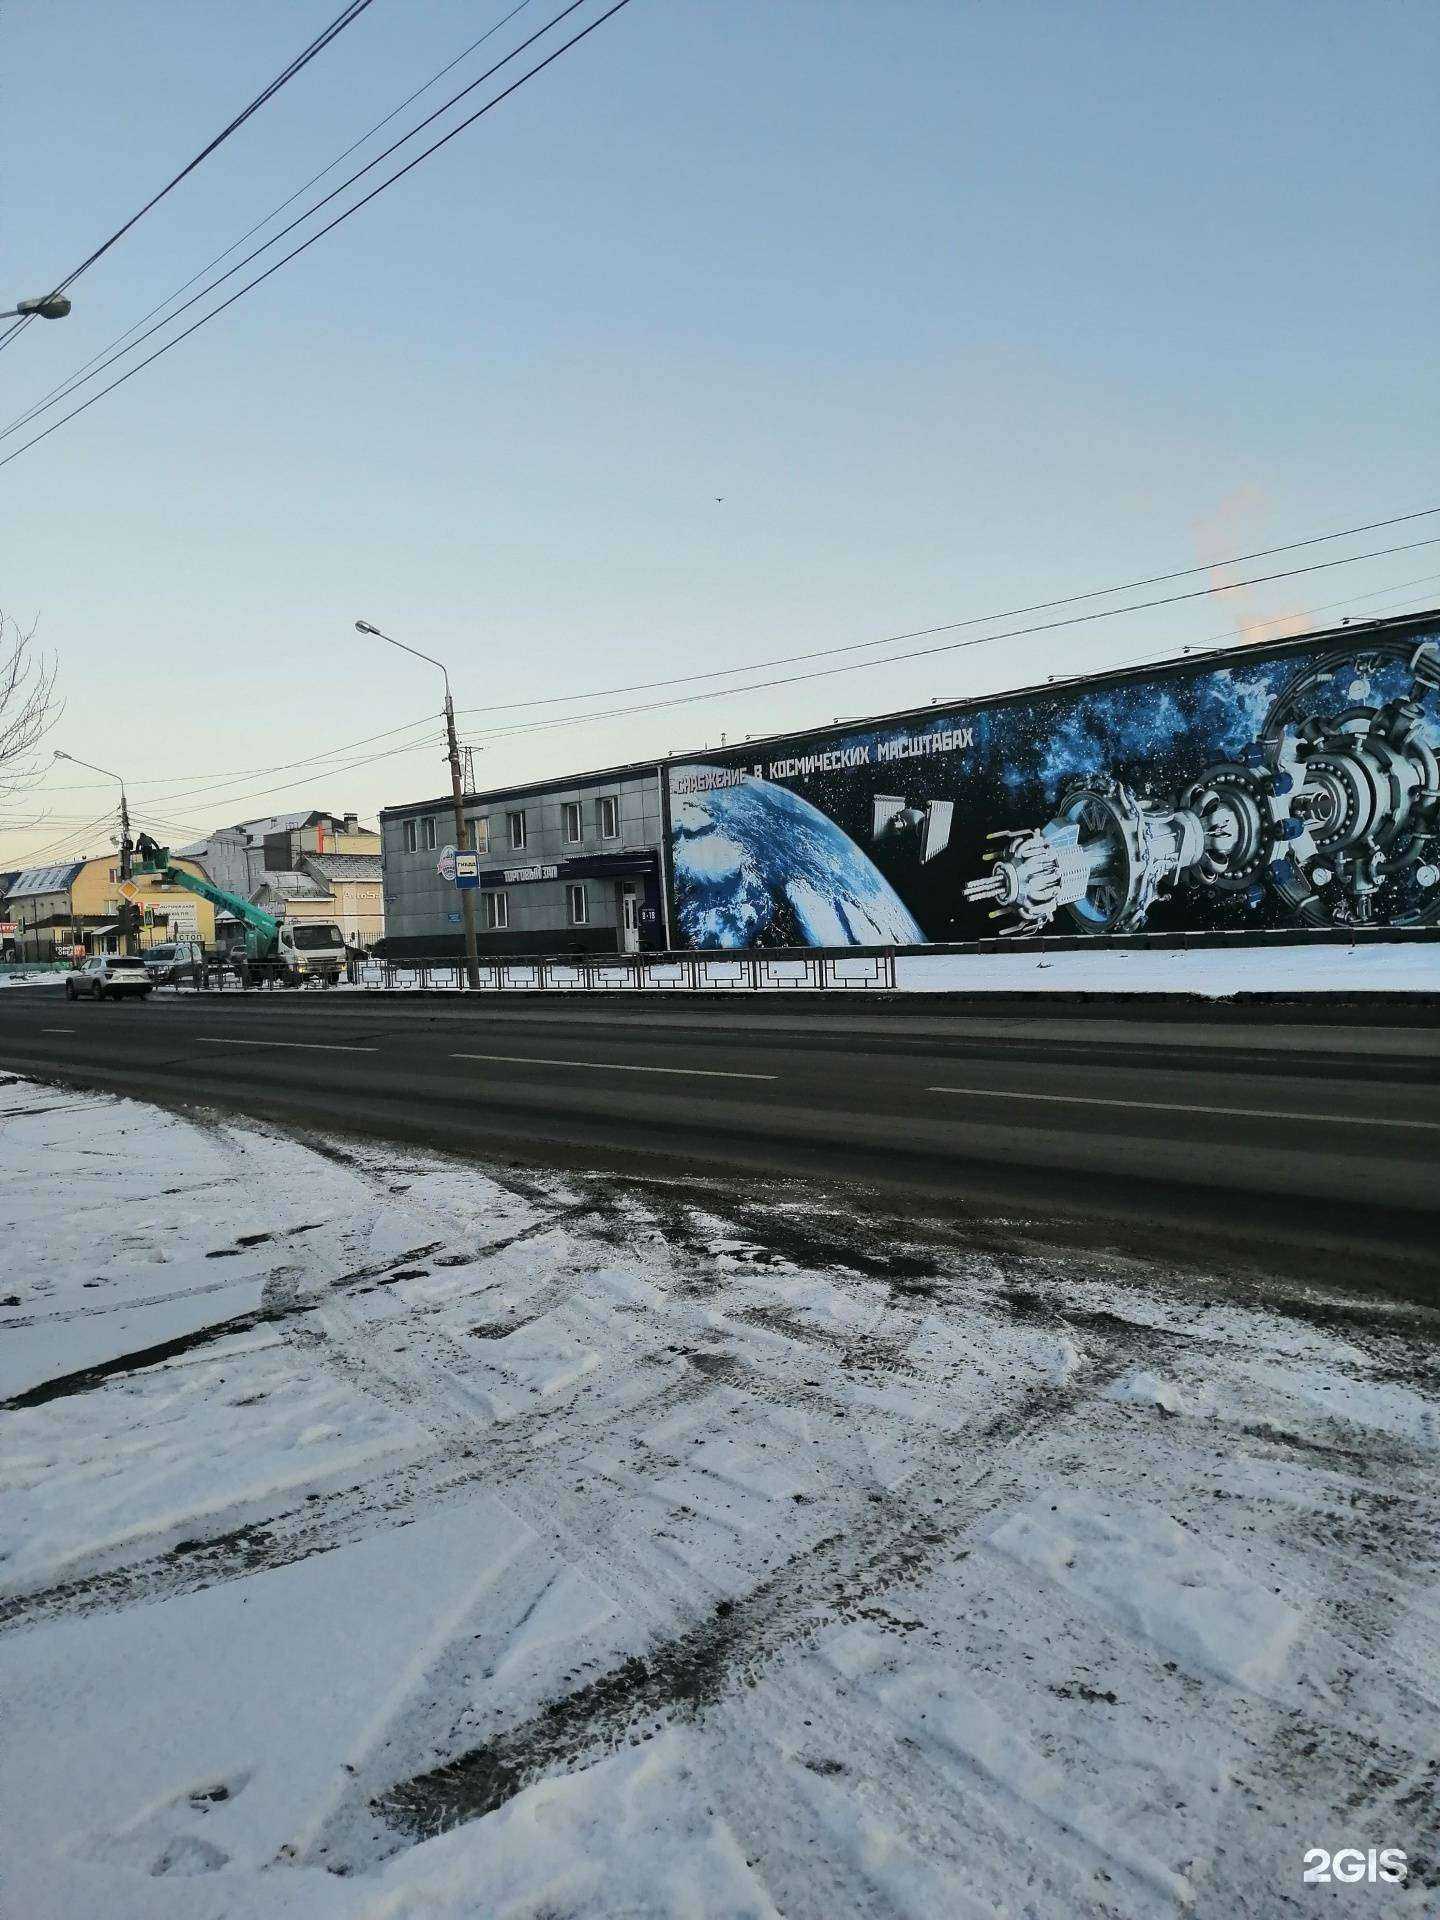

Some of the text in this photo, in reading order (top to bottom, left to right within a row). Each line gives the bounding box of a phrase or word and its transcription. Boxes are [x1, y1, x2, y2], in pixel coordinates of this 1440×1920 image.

[753, 764, 763, 781] В
[769, 745, 870, 780] КОСМИЧЕСКИХ
[877, 727, 975, 762] МАСШТАБАХ
